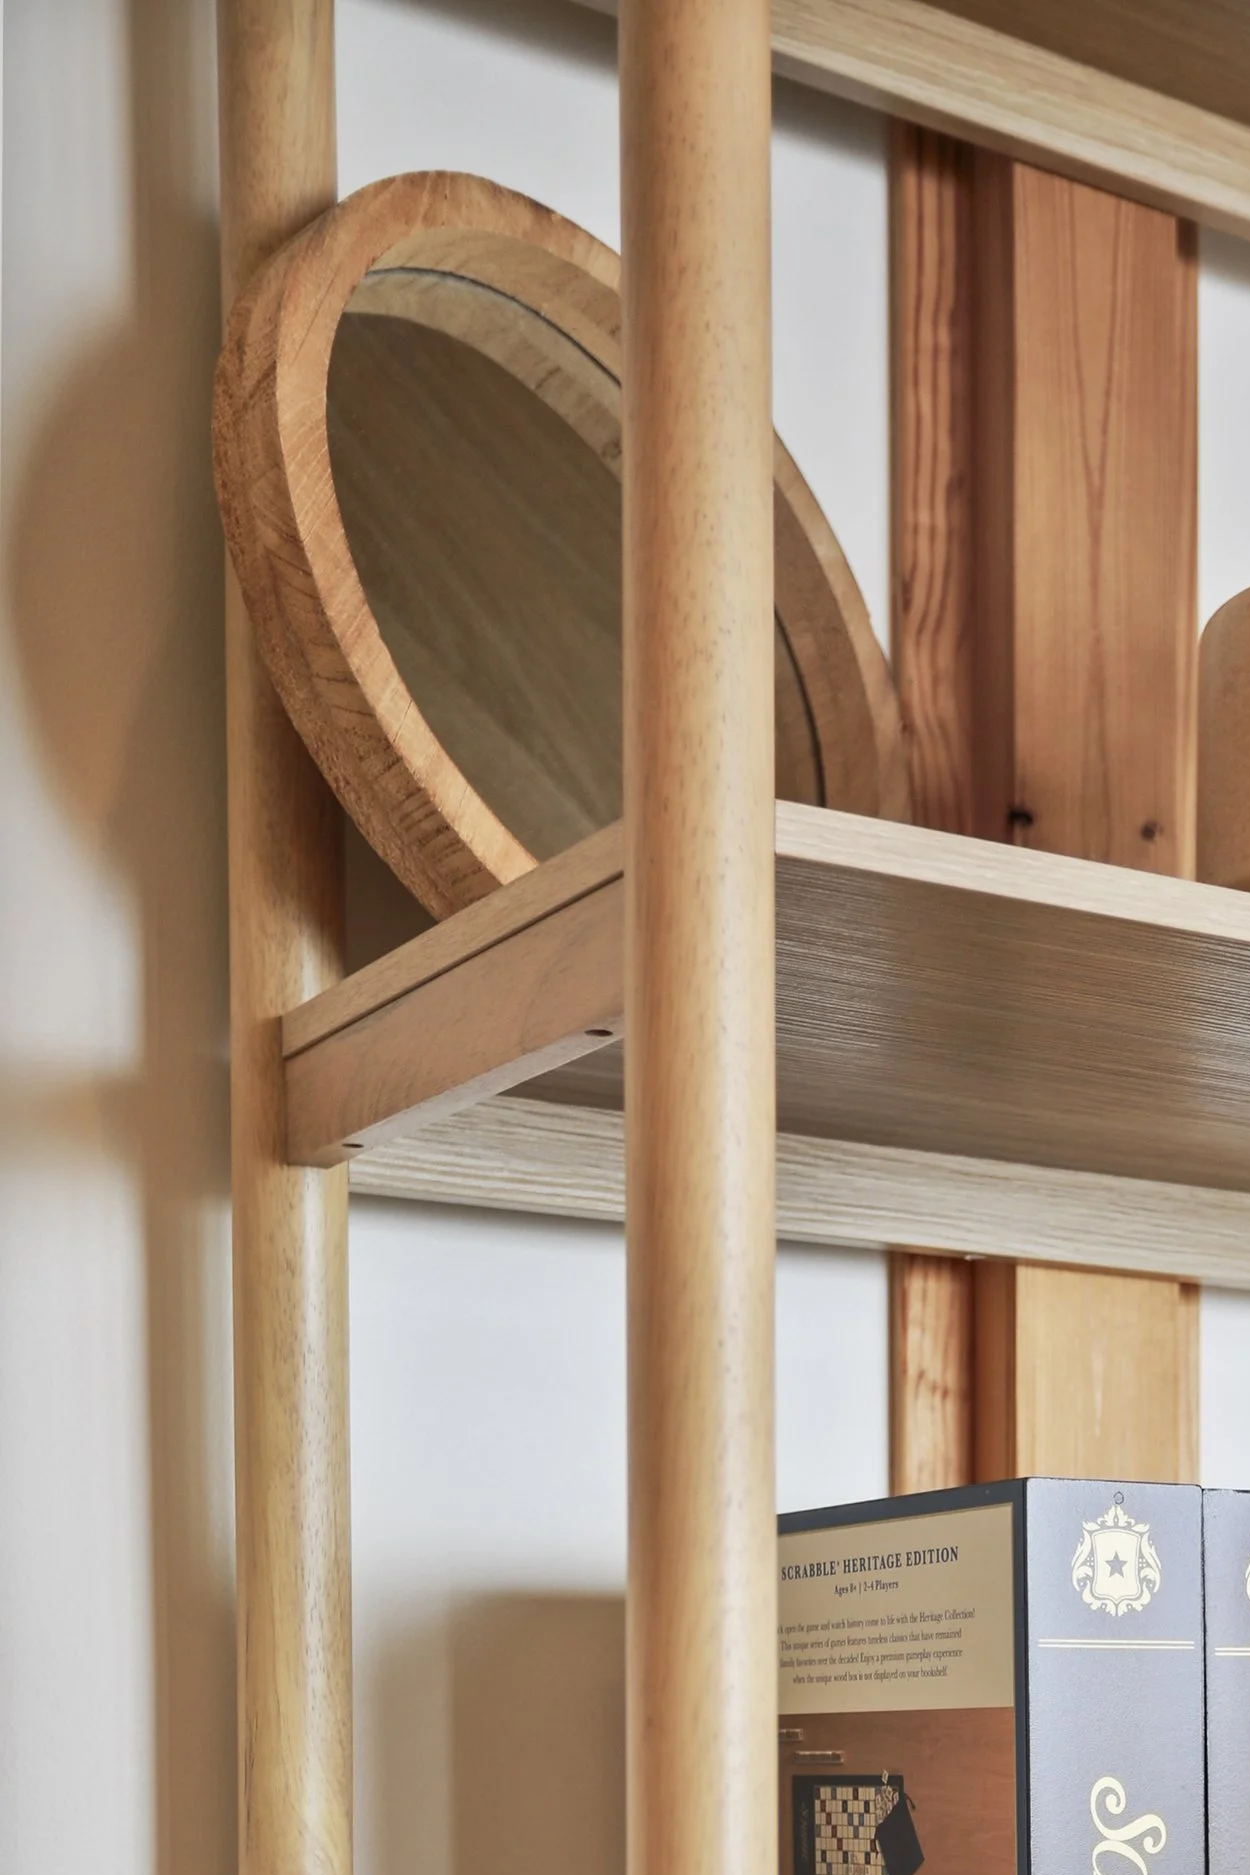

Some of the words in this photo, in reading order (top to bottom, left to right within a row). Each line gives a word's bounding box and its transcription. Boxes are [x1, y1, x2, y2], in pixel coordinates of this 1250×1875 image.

[843, 1552, 901, 1574] HERITAGE
[906, 1546, 959, 1567] EDITION
[834, 1584, 849, 1597] Ages
[875, 1579, 899, 1592] Players
[896, 1613, 908, 1624] with
[910, 1612, 918, 1623] the
[919, 1611, 943, 1624] Heritage
[909, 1631, 920, 1641] that
[921, 1629, 934, 1640] have
[935, 1627, 962, 1640] remained
[860, 1652, 874, 1665] Enjoy
[932, 1649, 963, 1661] experience
[834, 1671, 847, 1681] wood
[907, 1670, 920, 1681] your
